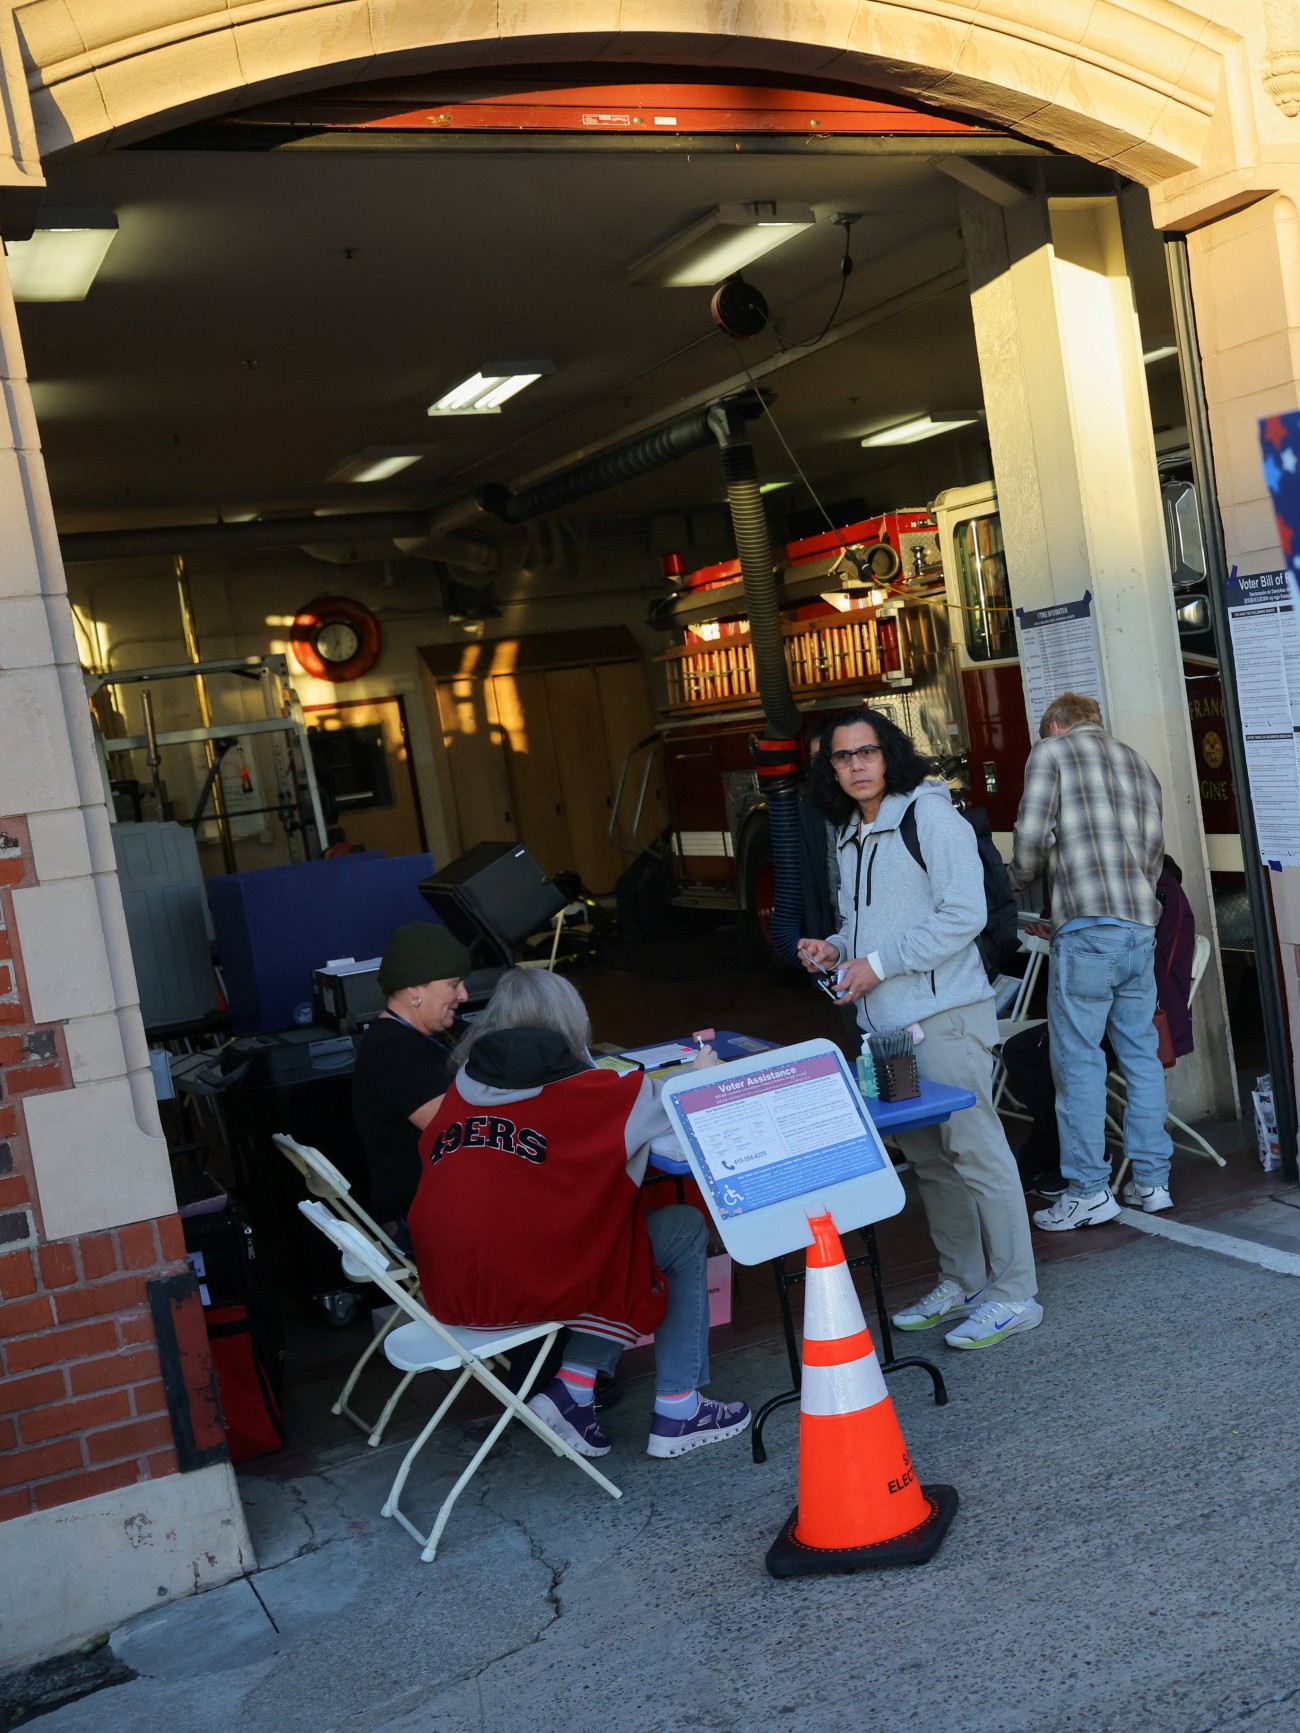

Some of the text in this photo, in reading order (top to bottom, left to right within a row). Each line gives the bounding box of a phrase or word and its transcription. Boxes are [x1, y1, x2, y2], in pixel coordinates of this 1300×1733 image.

[1239, 579, 1259, 590] Voter
[1260, 575, 1274, 587] Bill
[1275, 573, 1284, 585] of
[1201, 780, 1229, 800] GINE
[718, 1081, 745, 1094] Voter
[747, 1067, 797, 1087] Assistance
